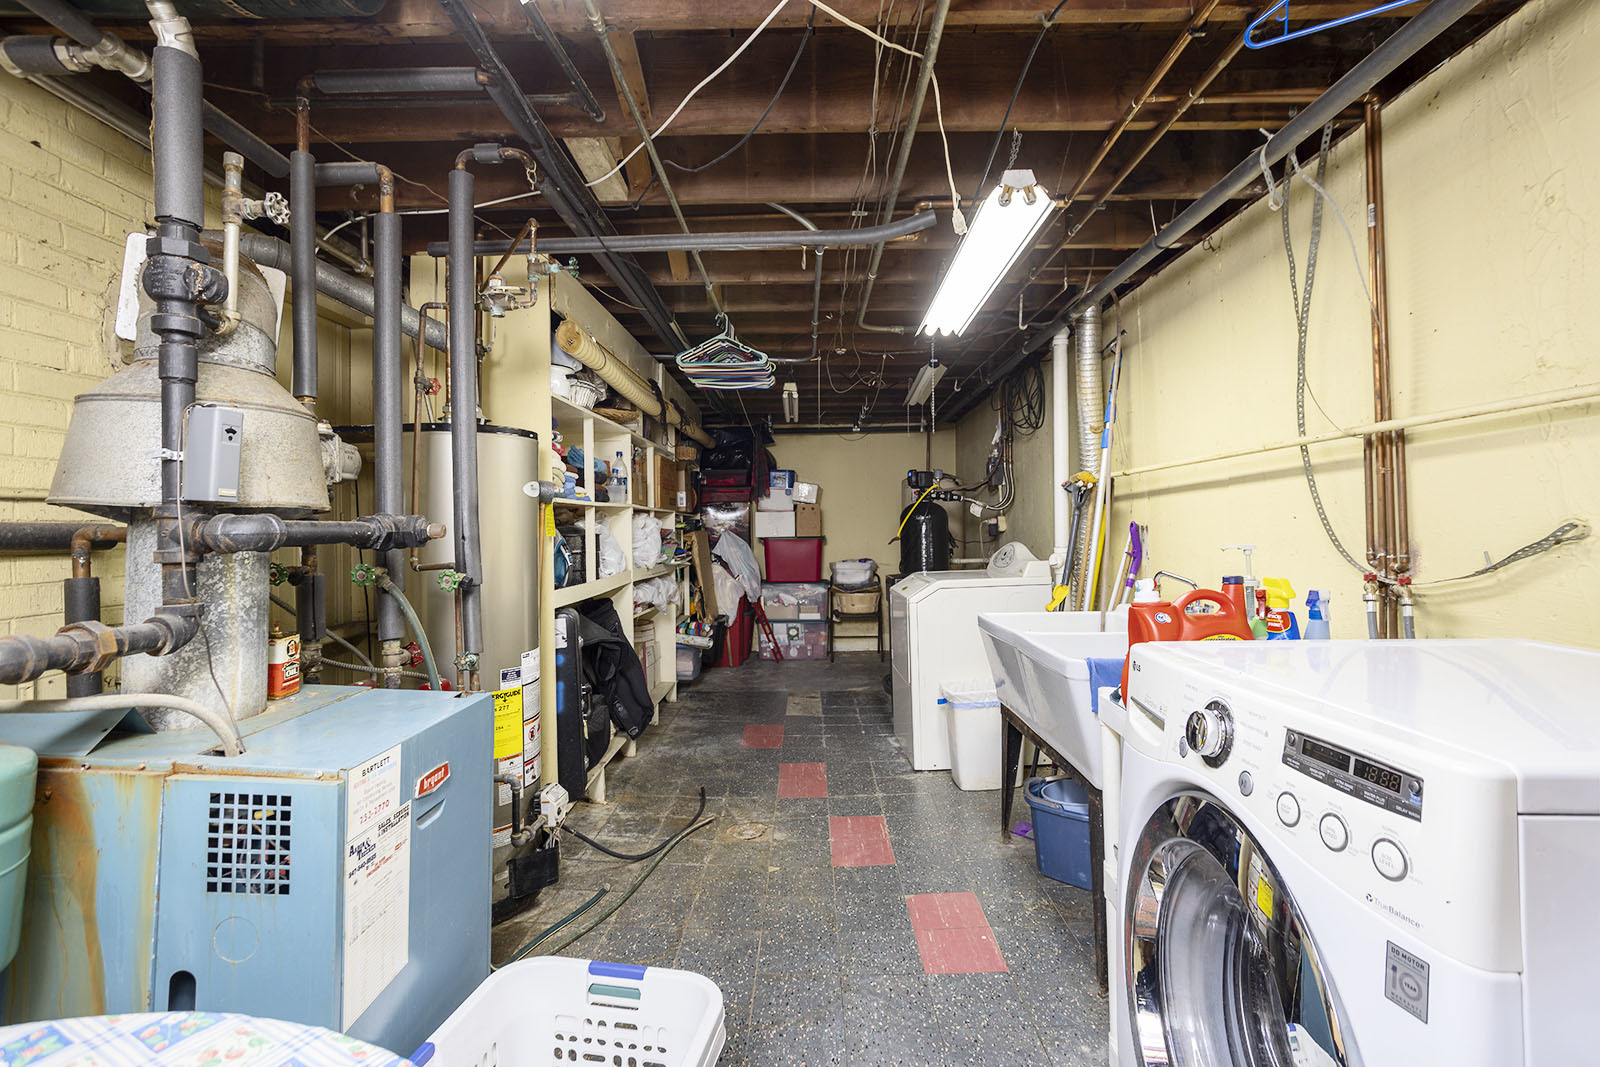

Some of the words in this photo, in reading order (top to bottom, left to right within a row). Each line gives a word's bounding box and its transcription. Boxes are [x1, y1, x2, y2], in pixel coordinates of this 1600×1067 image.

[361, 756, 390, 777] BARTLETT
[423, 766, 445, 790] bryant
[1374, 896, 1421, 928] TrueBalance
[1401, 953, 1425, 971] MOTOR
[1404, 981, 1417, 992] YEAR
